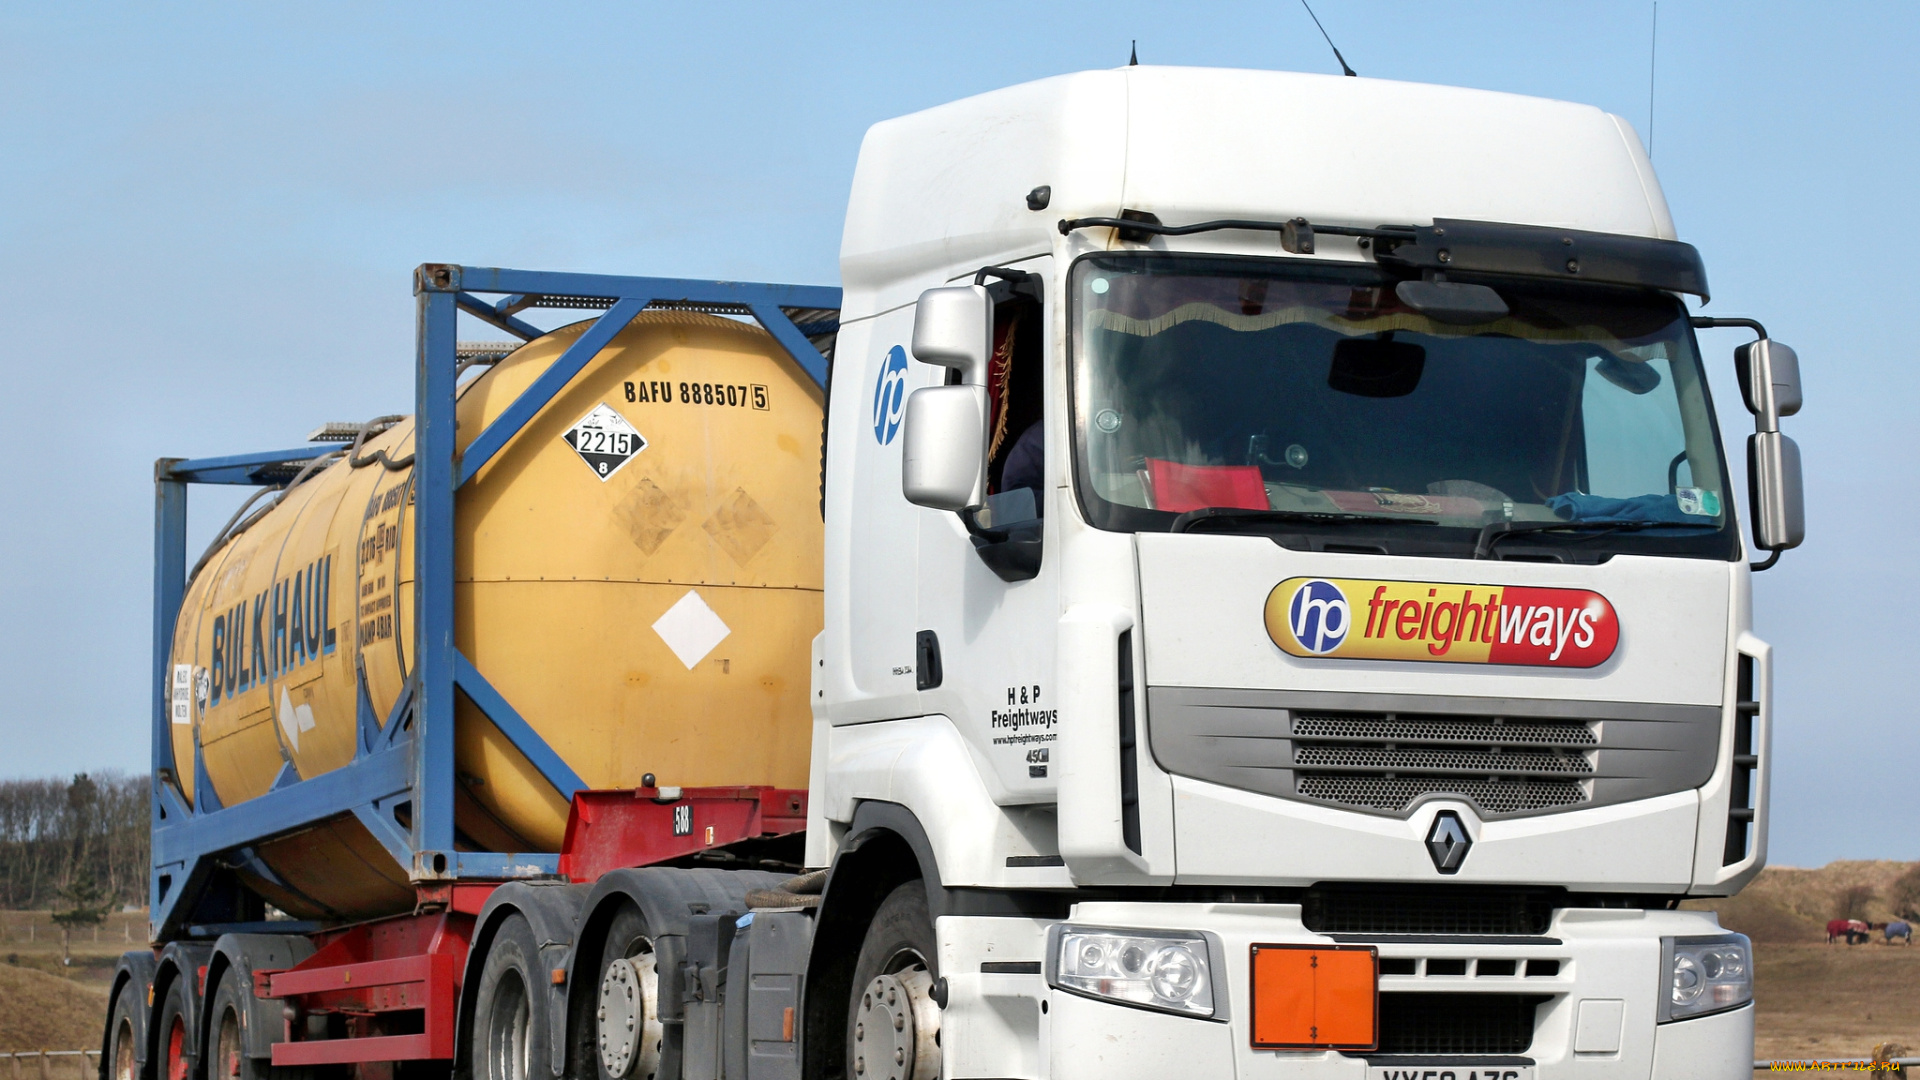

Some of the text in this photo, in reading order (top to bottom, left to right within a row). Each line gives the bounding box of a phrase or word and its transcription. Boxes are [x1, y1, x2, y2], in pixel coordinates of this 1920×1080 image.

[624, 381, 672, 403] BAFU
[680, 382, 747, 407] 888507
[580, 431, 629, 454] 2215
[598, 462, 608, 474] 8
[1297, 586, 1350, 652] hp
[1008, 685, 1041, 705] H & P
[991, 708, 1057, 731] Freightways
[675, 805, 689, 834] 588
